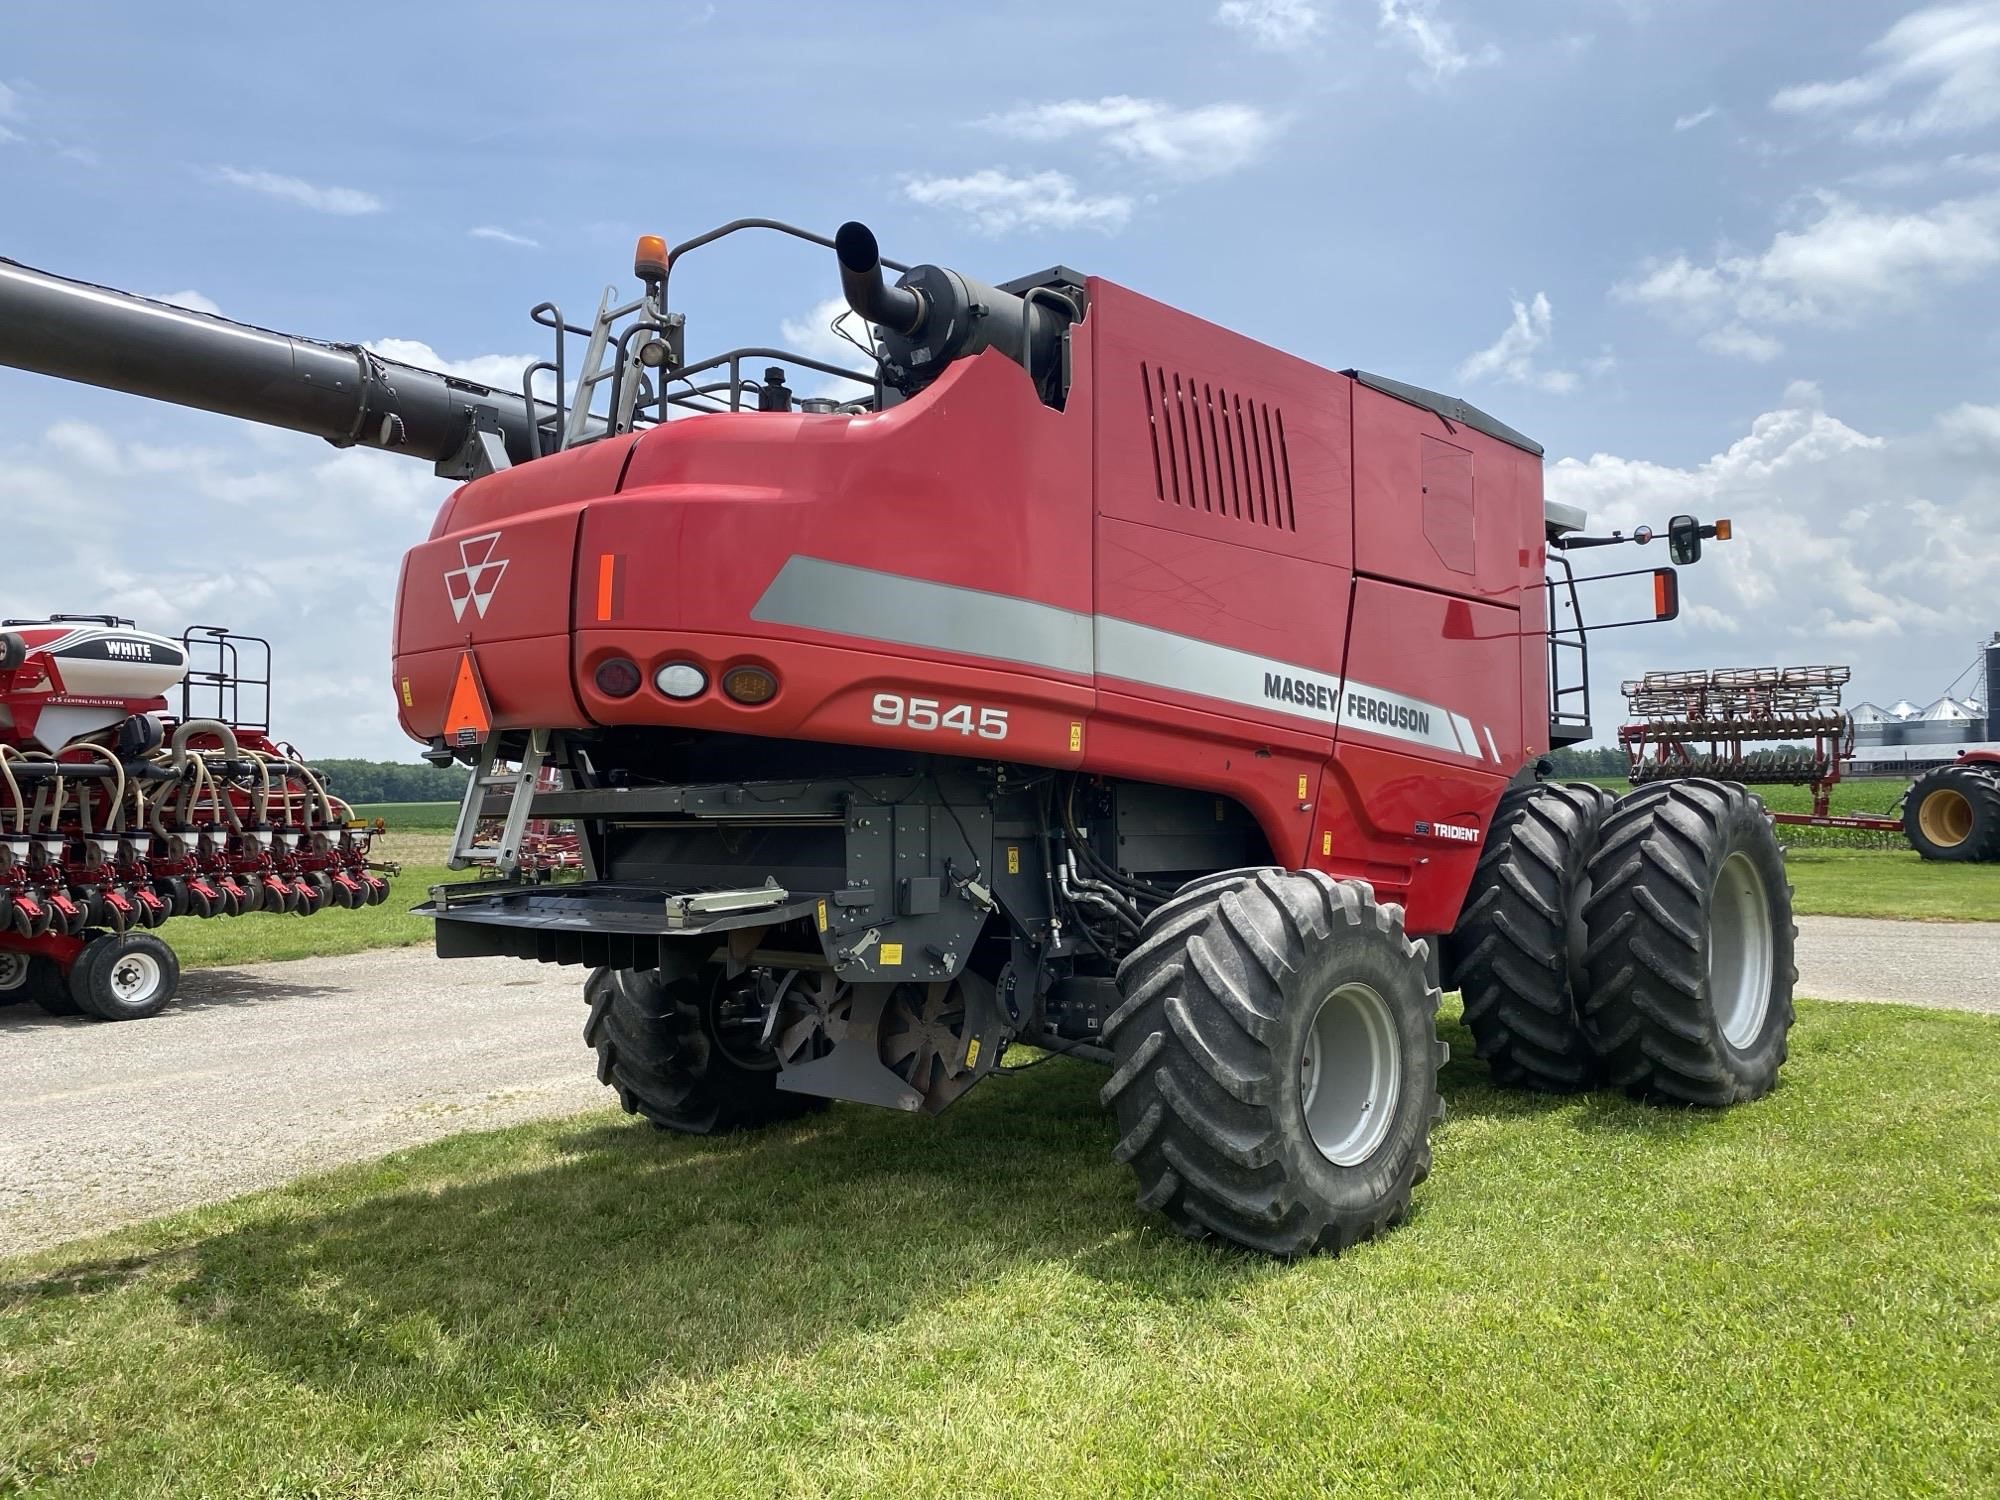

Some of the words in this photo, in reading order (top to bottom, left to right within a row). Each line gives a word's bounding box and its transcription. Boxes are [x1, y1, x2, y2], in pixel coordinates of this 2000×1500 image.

[105, 641, 151, 657] WHITE
[871, 693, 1008, 740] 9545
[1264, 672, 1338, 713] MASSEY
[1347, 693, 1429, 735] FERGUSON
[1433, 822, 1480, 842] TRIDENT
